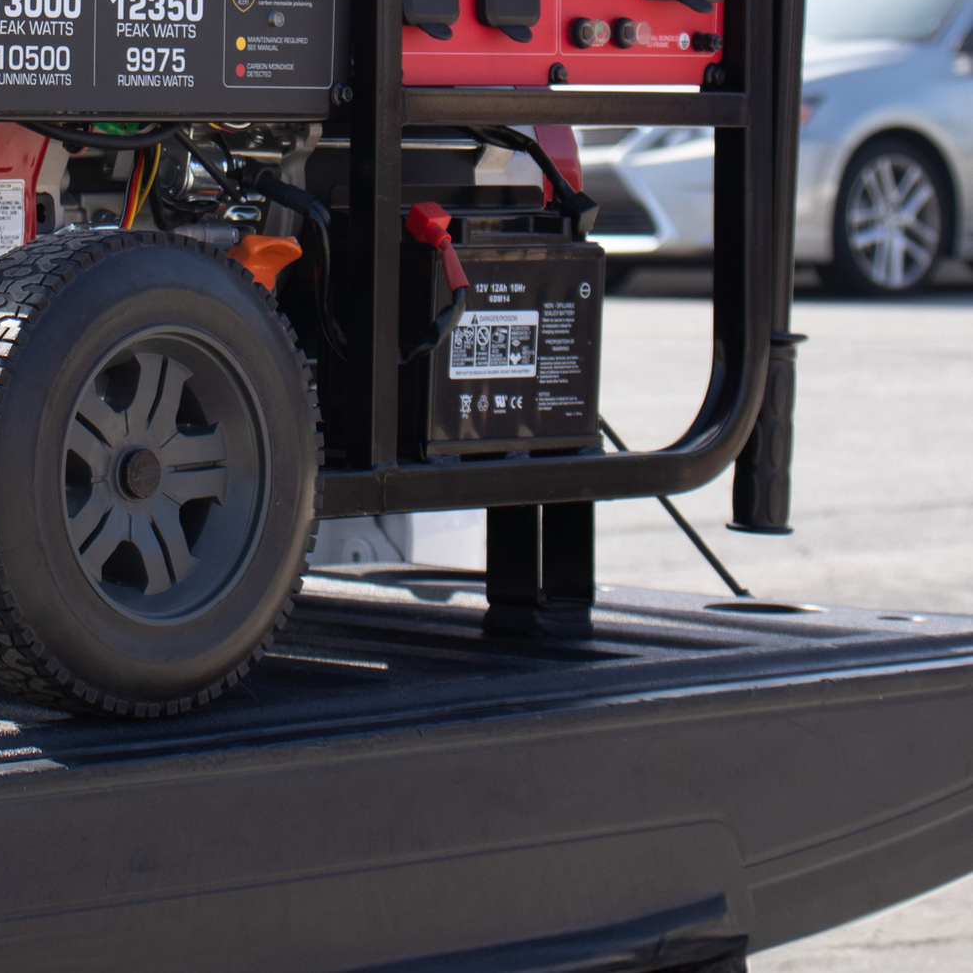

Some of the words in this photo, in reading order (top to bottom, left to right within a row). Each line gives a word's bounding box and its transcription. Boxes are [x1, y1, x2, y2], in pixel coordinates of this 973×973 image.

[29, 21, 74, 36] WATTS
[116, 23, 150, 38] PEAK
[154, 24, 197, 39] WATTS
[126, 47, 186, 73] 9975
[39, 74, 72, 86] WATTS
[117, 75, 160, 87] RUNNING
[162, 75, 194, 88] WATTS
[476, 284, 488, 292] 12V
[491, 283, 508, 292] 12Ah
[511, 283, 526, 292] 10Hr
[479, 315, 518, 323] DANGER/POISON
[511, 395, 523, 409] CE
